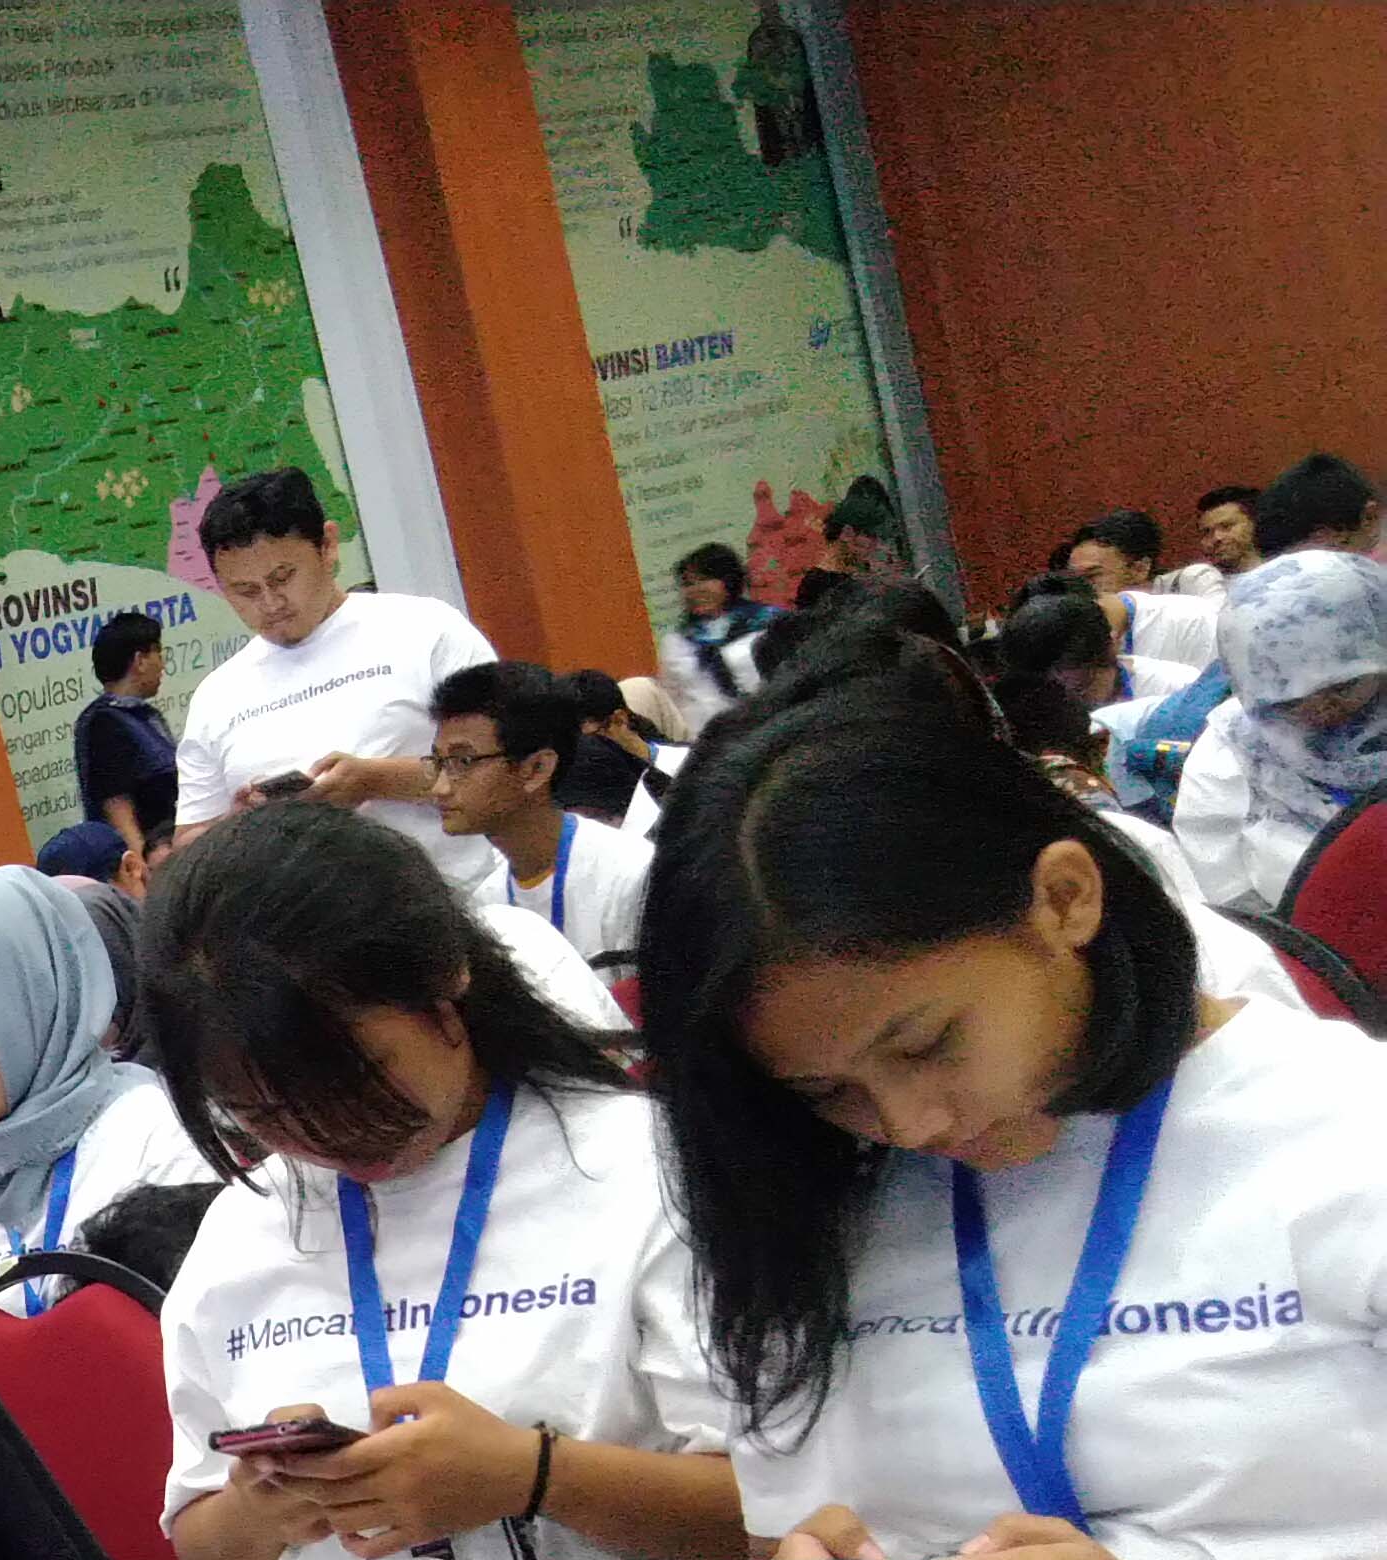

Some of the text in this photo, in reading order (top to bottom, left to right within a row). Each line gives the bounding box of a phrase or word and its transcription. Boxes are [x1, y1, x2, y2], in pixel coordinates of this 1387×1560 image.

[594, 329, 735, 381] VINSI BANTEN
[227, 664, 393, 729] #MencatatIndonesia
[5, 727, 54, 757] engan
[13, 757, 76, 789] epadata
[20, 791, 78, 822] endudu
